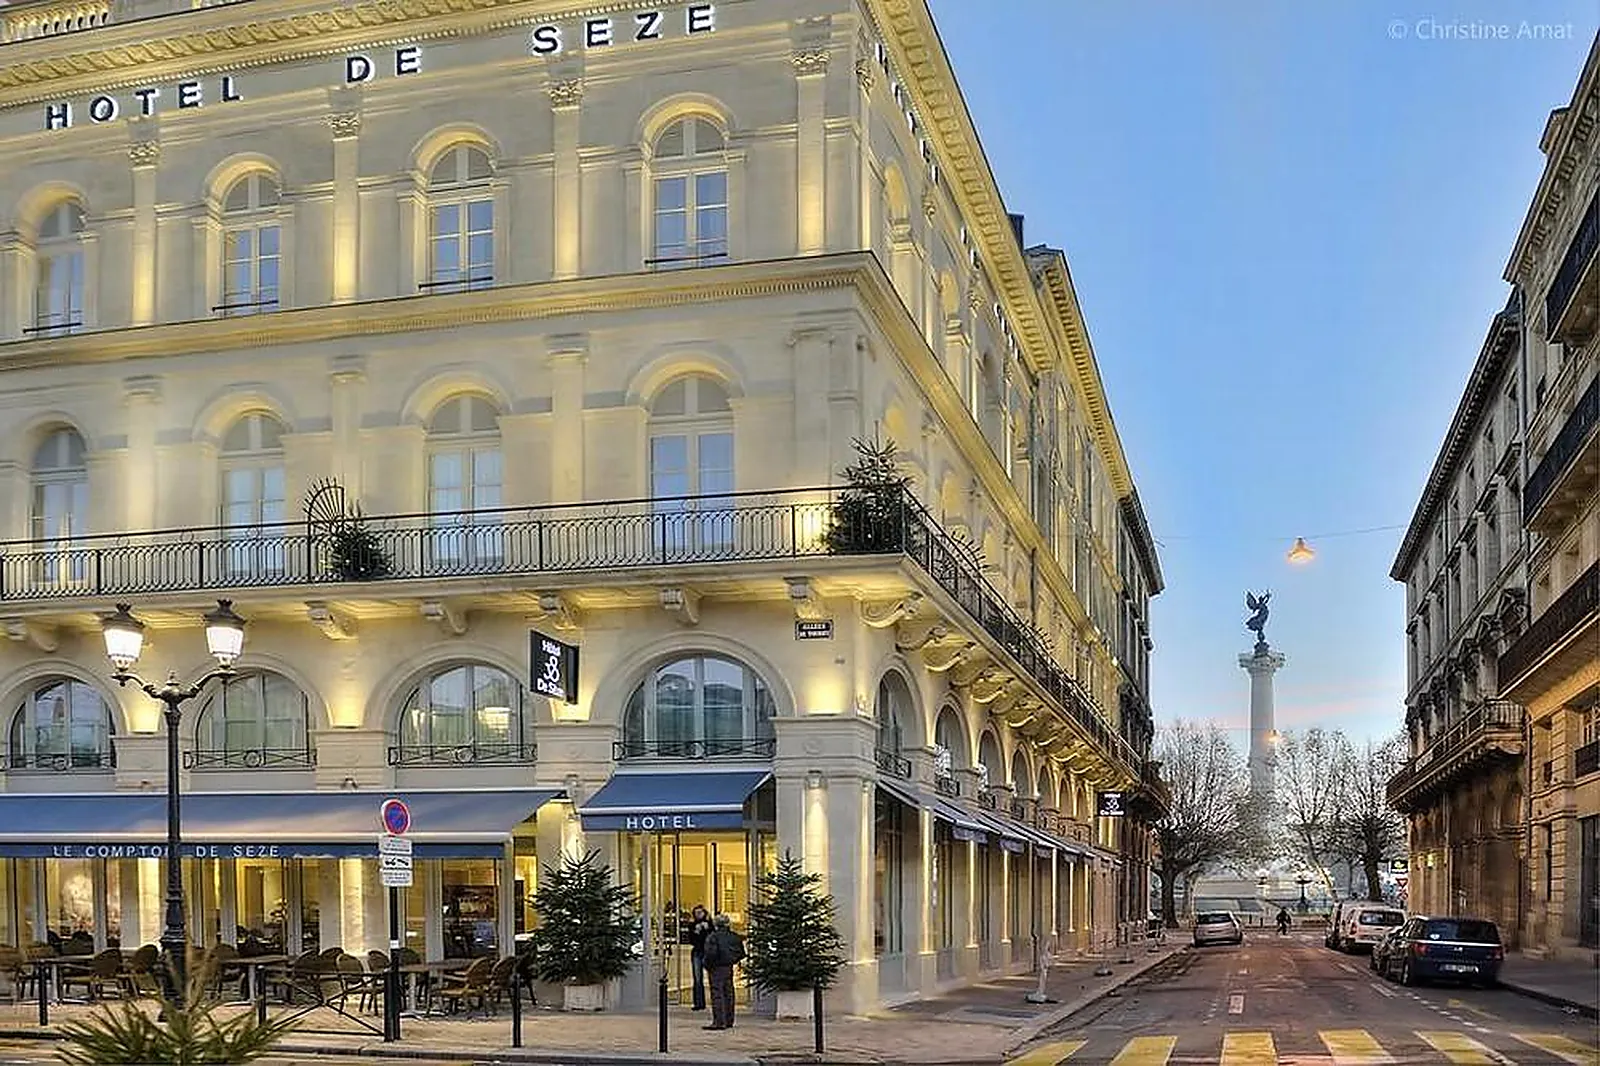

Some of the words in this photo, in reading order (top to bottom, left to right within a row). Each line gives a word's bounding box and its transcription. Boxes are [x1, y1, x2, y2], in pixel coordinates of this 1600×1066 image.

[46, 76, 243, 131] HOTEL
[345, 47, 422, 85] DE
[531, 3, 715, 57] SEZE
[626, 815, 696, 830] HOTEL
[53, 845, 72, 858] LE
[196, 845, 218, 858] DE
[233, 845, 279, 858] SEZE
